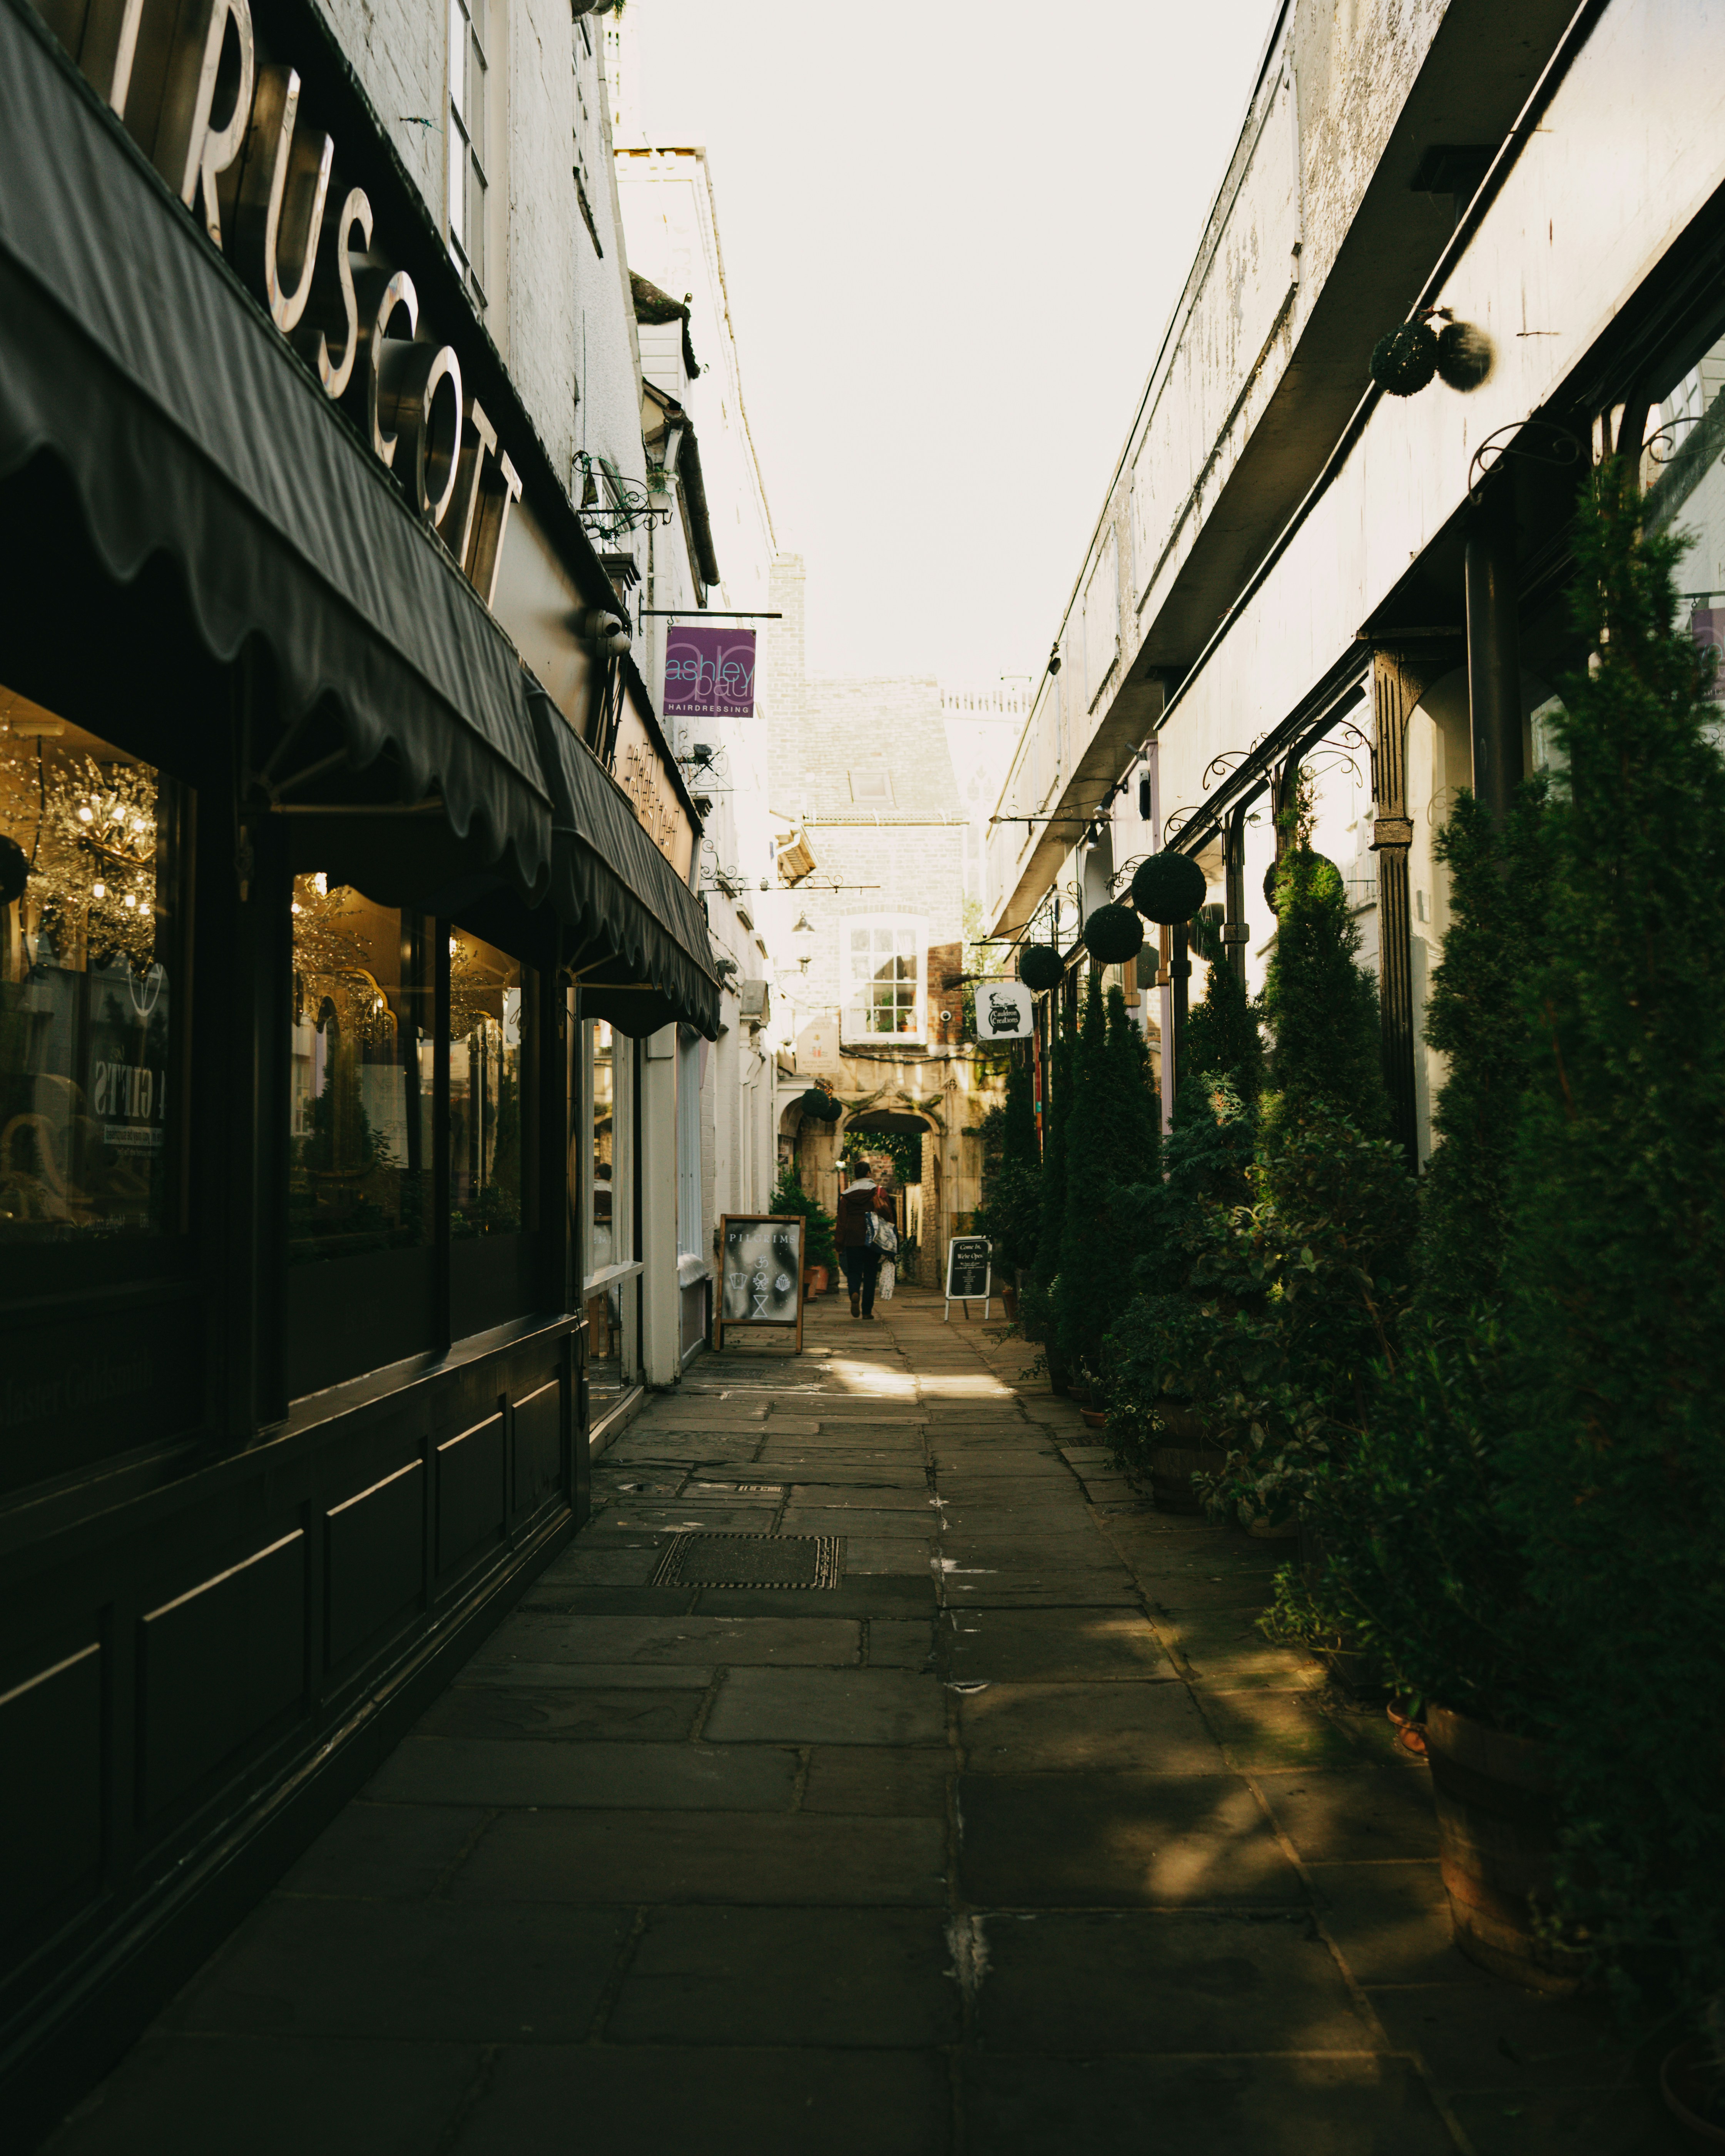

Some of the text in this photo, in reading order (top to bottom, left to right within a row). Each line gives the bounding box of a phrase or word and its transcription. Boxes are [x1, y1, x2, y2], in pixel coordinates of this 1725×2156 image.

[665, 654, 755, 688] ashley
[694, 670, 754, 701] paul
[668, 704, 749, 713] HAIRDRESSING
[730, 1233, 796, 1243] PILGRIMS
[65, 1345, 153, 1409] Goldsmith
